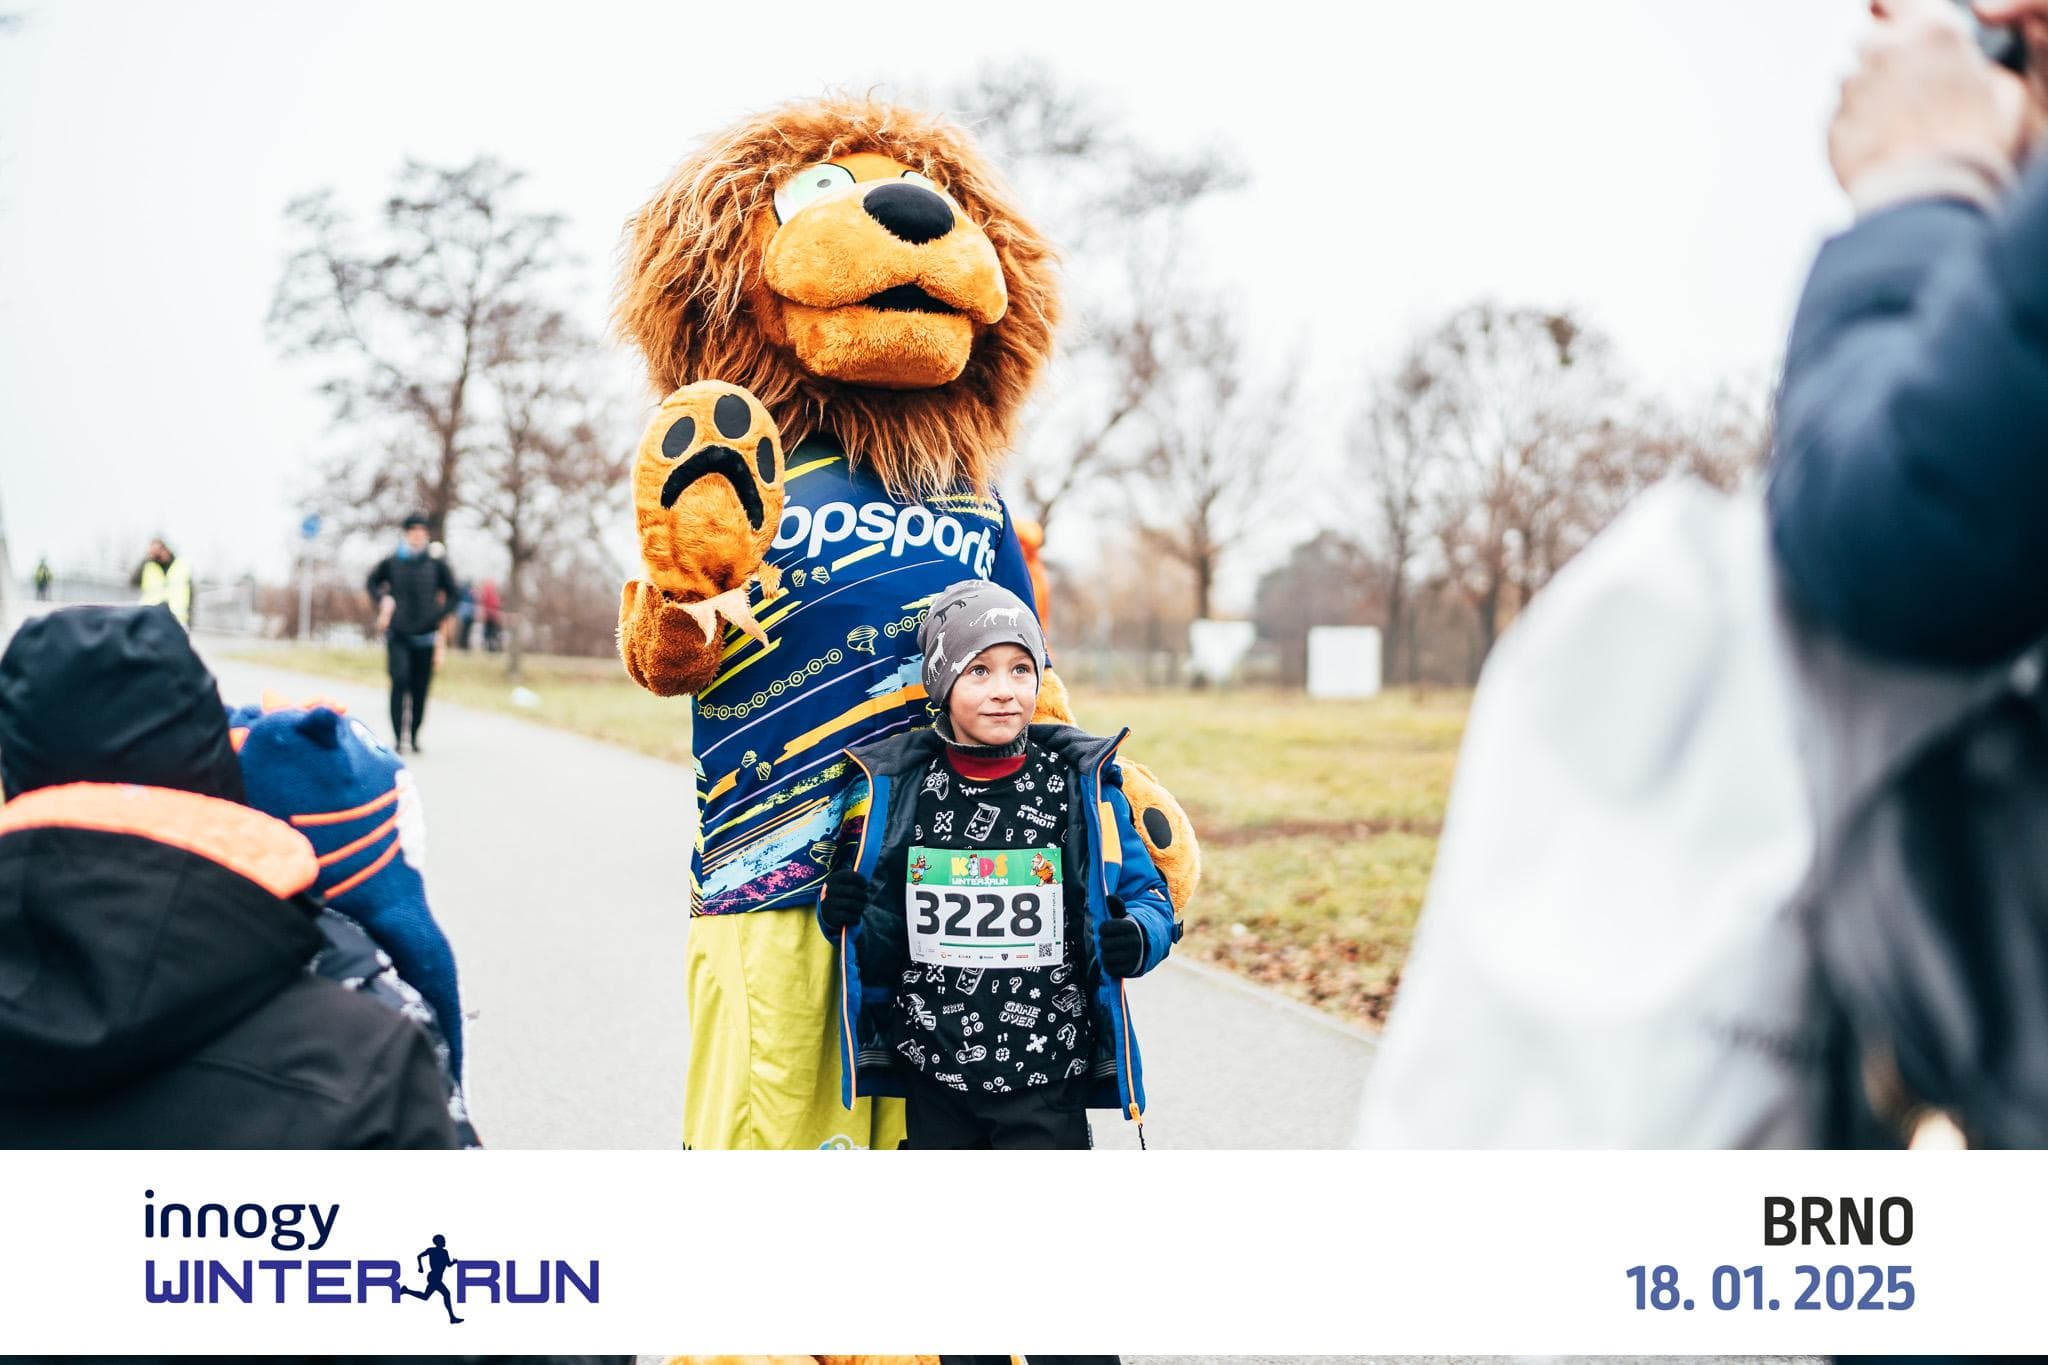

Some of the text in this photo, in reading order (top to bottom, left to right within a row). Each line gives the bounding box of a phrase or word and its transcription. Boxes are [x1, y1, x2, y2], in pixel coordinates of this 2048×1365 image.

[771, 496, 996, 581] opsports
[1016, 810, 1025, 819] A
[915, 891, 1042, 937] 3228
[1004, 1001, 1042, 1019] GAME
[998, 1011, 1036, 1029] OVER
[935, 1071, 964, 1083] GAME
